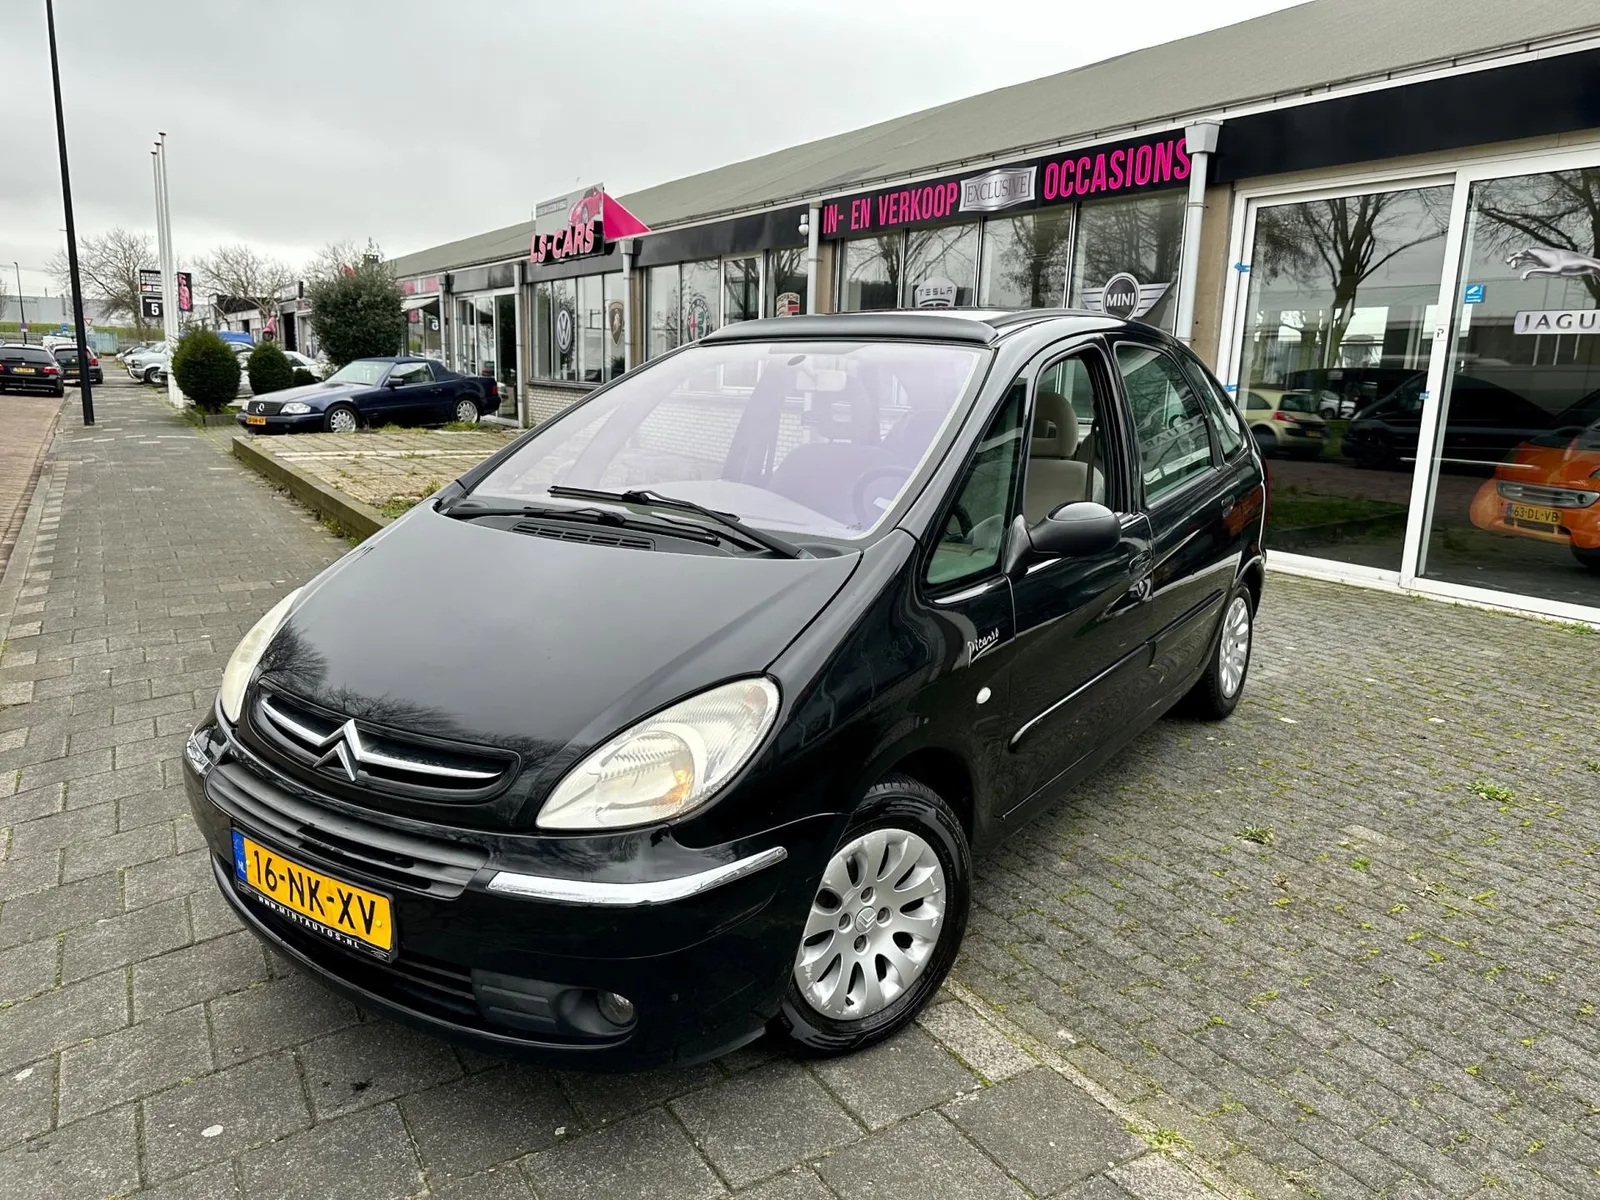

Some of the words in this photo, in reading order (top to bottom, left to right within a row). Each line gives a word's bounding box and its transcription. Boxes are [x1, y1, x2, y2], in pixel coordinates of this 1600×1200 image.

[823, 203, 844, 235] IN-
[850, 197, 872, 230] EN
[878, 181, 959, 226] VERKOOP
[967, 174, 1028, 204] EXCLUSIVE
[1043, 137, 1192, 200] OCCASIONS
[530, 219, 595, 263] LS-CARS
[918, 285, 954, 295] TESLA
[1106, 291, 1135, 308] MINI
[151, 302, 160, 316] 5
[1521, 312, 1600, 332] JAGU
[253, 849, 376, 935] 16-NK-XV
